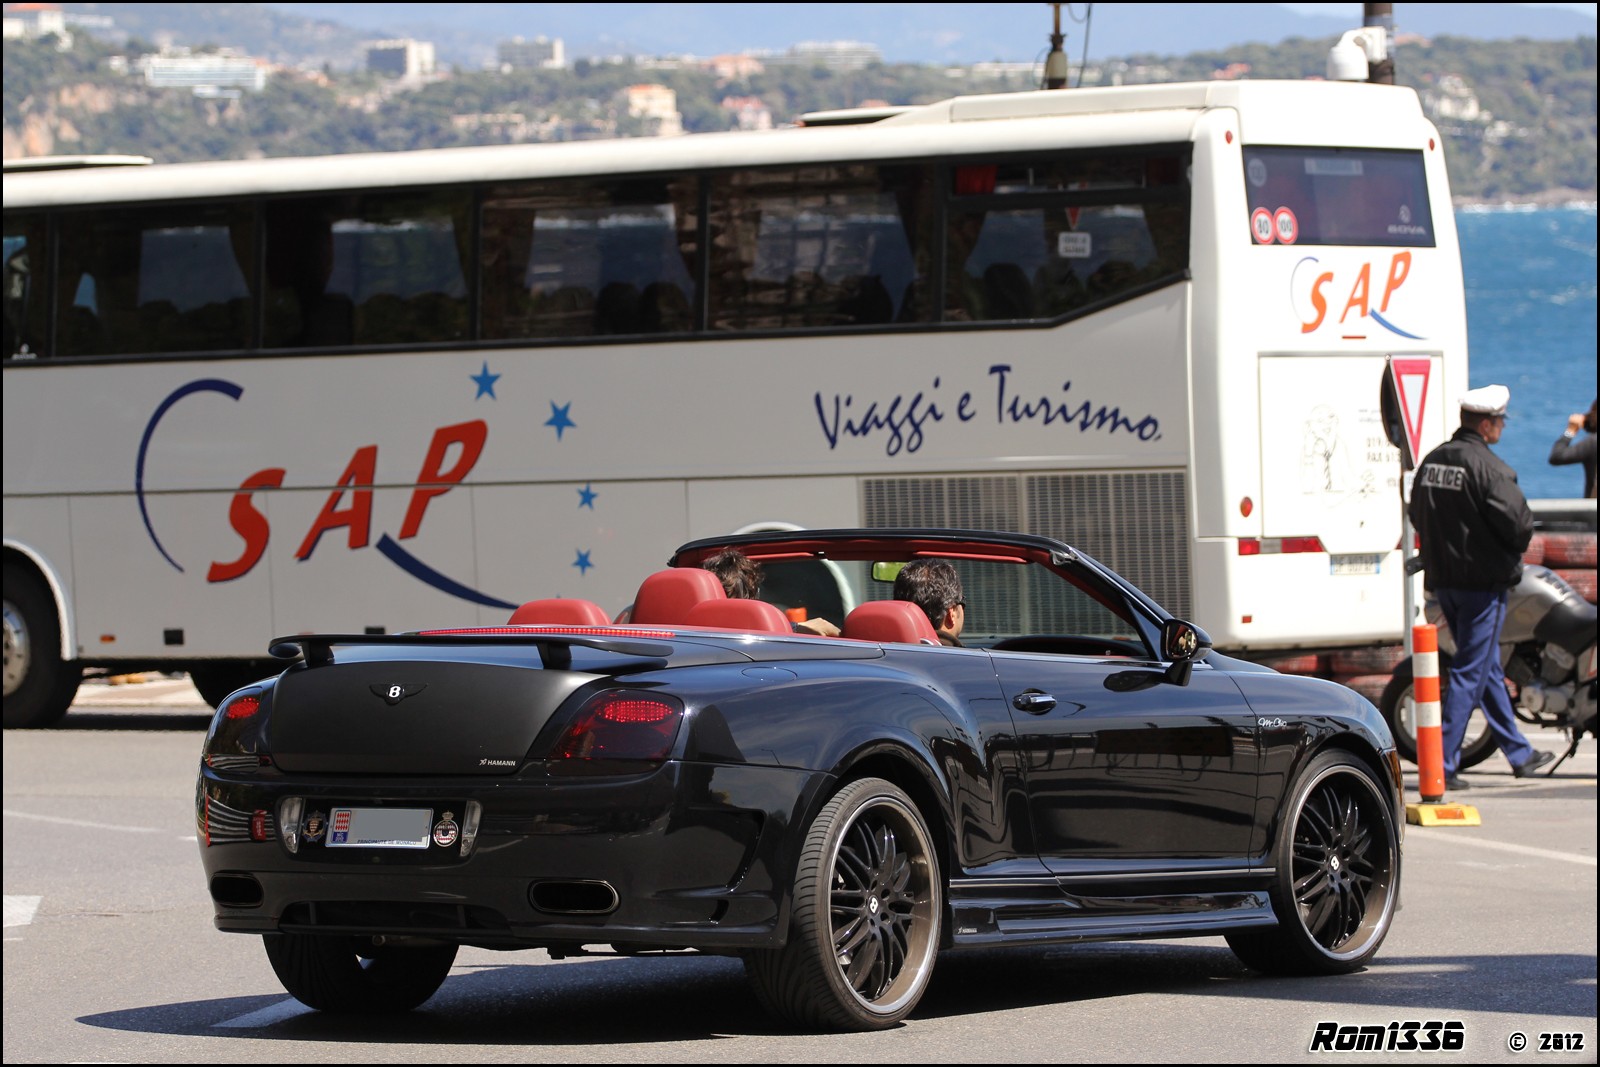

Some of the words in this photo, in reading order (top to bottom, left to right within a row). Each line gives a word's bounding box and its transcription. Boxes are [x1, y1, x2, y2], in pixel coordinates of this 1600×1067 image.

[1387, 224, 1426, 236] BOVA
[1301, 251, 1412, 333] SAP
[814, 376, 944, 456] Viaggi
[956, 392, 977, 422] e
[206, 419, 489, 584] SAP
[487, 759, 516, 767] HAMANN
